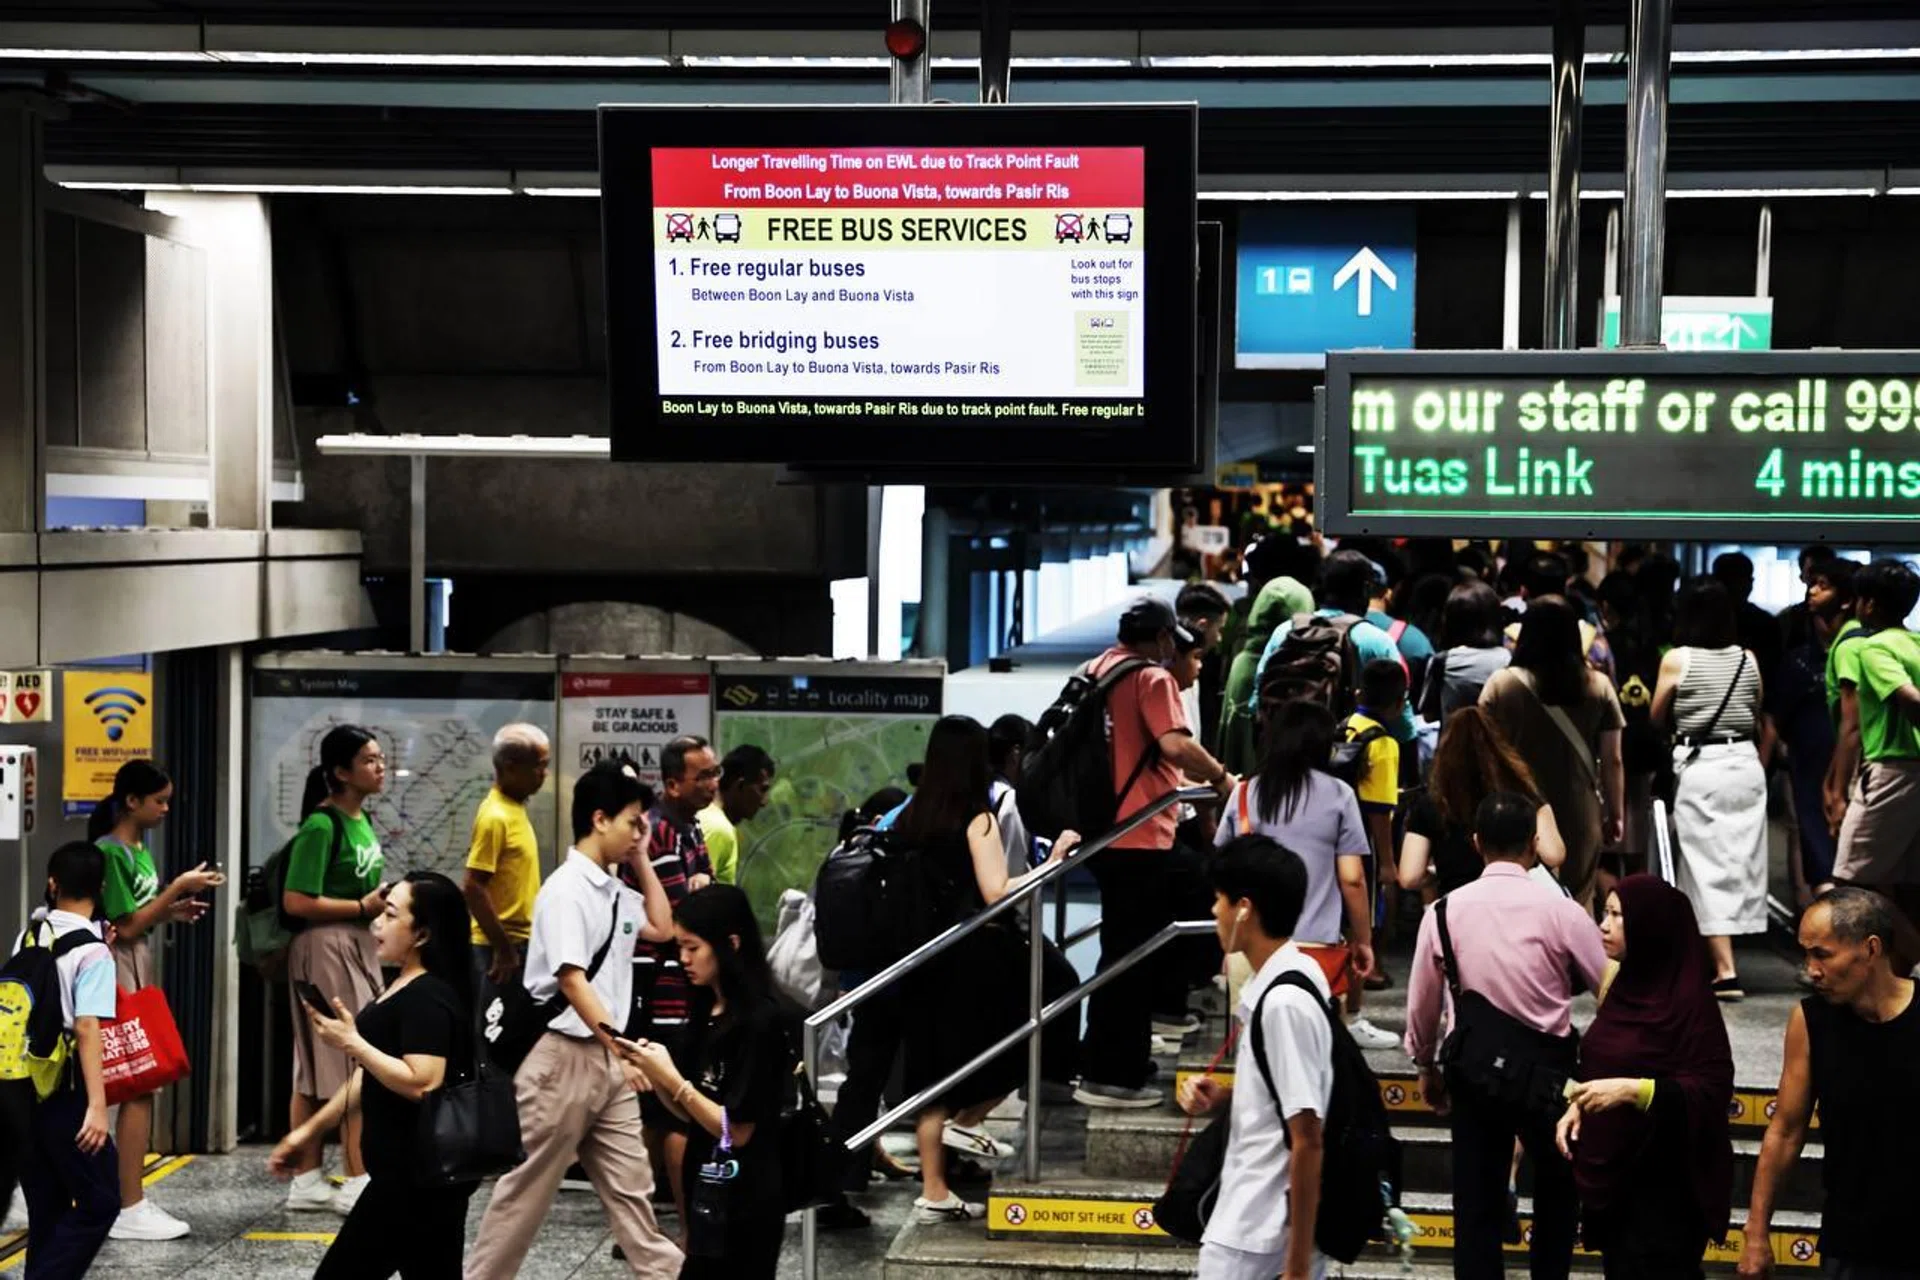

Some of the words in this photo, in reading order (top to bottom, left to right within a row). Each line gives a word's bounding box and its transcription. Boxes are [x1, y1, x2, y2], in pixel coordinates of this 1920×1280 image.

[712, 154, 760, 171] Longer
[762, 154, 827, 171] Travelling
[830, 154, 862, 170] Time
[866, 158, 883, 170] on
[886, 154, 918, 170] EWL
[920, 154, 946, 170] due
[949, 155, 964, 170] to
[966, 154, 1004, 170] Track
[1006, 154, 1042, 170] Point
[1045, 154, 1080, 170] Fault
[724, 184, 761, 200] From
[764, 184, 802, 200] Boon
[805, 184, 832, 203] Lay
[834, 185, 848, 200] to
[852, 184, 898, 200] Buona
[901, 184, 941, 202] Vista,
[945, 184, 1002, 200] towards
[1006, 184, 1042, 200] Pasir
[1046, 184, 1070, 200] Ris
[767, 217, 832, 242] FREE
[841, 217, 892, 242] BUS
[901, 217, 1027, 242] SERVICES
[669, 258, 684, 276] 1.
[690, 258, 731, 276] Free
[737, 258, 804, 281] regular
[810, 258, 866, 276] buses
[1071, 260, 1096, 269] Look
[1099, 260, 1116, 269] out
[1118, 260, 1132, 269] for
[1071, 274, 1090, 284] bus
[1093, 274, 1122, 286] stops
[692, 289, 745, 302] Between
[748, 289, 782, 302] Boon
[786, 289, 808, 304] Lay
[812, 289, 835, 302] and
[839, 289, 879, 302] Buona
[883, 289, 914, 302] Vista
[1071, 290, 1092, 300] with
[1095, 290, 1114, 300] this
[1117, 290, 1138, 302] sign
[671, 330, 686, 349] 2.
[692, 330, 733, 349] Free
[740, 330, 817, 354] bridging
[824, 330, 880, 349] buses
[694, 361, 726, 374] From
[730, 361, 763, 374] Boon
[767, 361, 790, 376] Lay
[792, 361, 805, 374] to
[808, 361, 848, 374] Buona
[852, 361, 888, 376] Vista,
[890, 361, 940, 374] towards
[944, 361, 977, 374] Pasir
[980, 361, 1000, 374] Ris
[662, 402, 694, 415] Boon
[698, 402, 718, 417] Lay
[722, 402, 734, 415] to
[736, 402, 774, 415] Buona
[778, 402, 811, 416] Vista,
[814, 402, 862, 415] towards
[865, 402, 896, 415] Pasir
[898, 402, 918, 415] Ris
[922, 402, 944, 415] due
[946, 402, 958, 415] to
[962, 402, 992, 415] track
[994, 402, 1026, 418] point
[1028, 402, 1058, 415] fault.
[1062, 402, 1089, 415] Free
[1092, 403, 1134, 419] regular
[1412, 389, 1503, 432] our
[1518, 380, 1645, 432] staff
[1658, 389, 1716, 432] or
[1730, 379, 1826, 432] call
[1845, 380, 1920, 432] 99
[1354, 448, 1468, 495] Tuas
[1486, 448, 1594, 496] Link
[1755, 448, 1786, 497] 4
[1802, 448, 1920, 498] mins
[16, 674, 40, 688] AED
[830, 690, 888, 708] Locality
[894, 694, 929, 710] map
[595, 708, 627, 719] STAY
[631, 708, 663, 720] SAFE
[666, 708, 675, 720] &
[592, 722, 609, 733] BE
[612, 722, 678, 733] GRACIOUS
[24, 755, 35, 832] AED
[1033, 1210, 1050, 1221] DO
[1052, 1212, 1074, 1222] NOT
[1078, 1212, 1094, 1223] SIT
[1097, 1213, 1126, 1224] HERE
